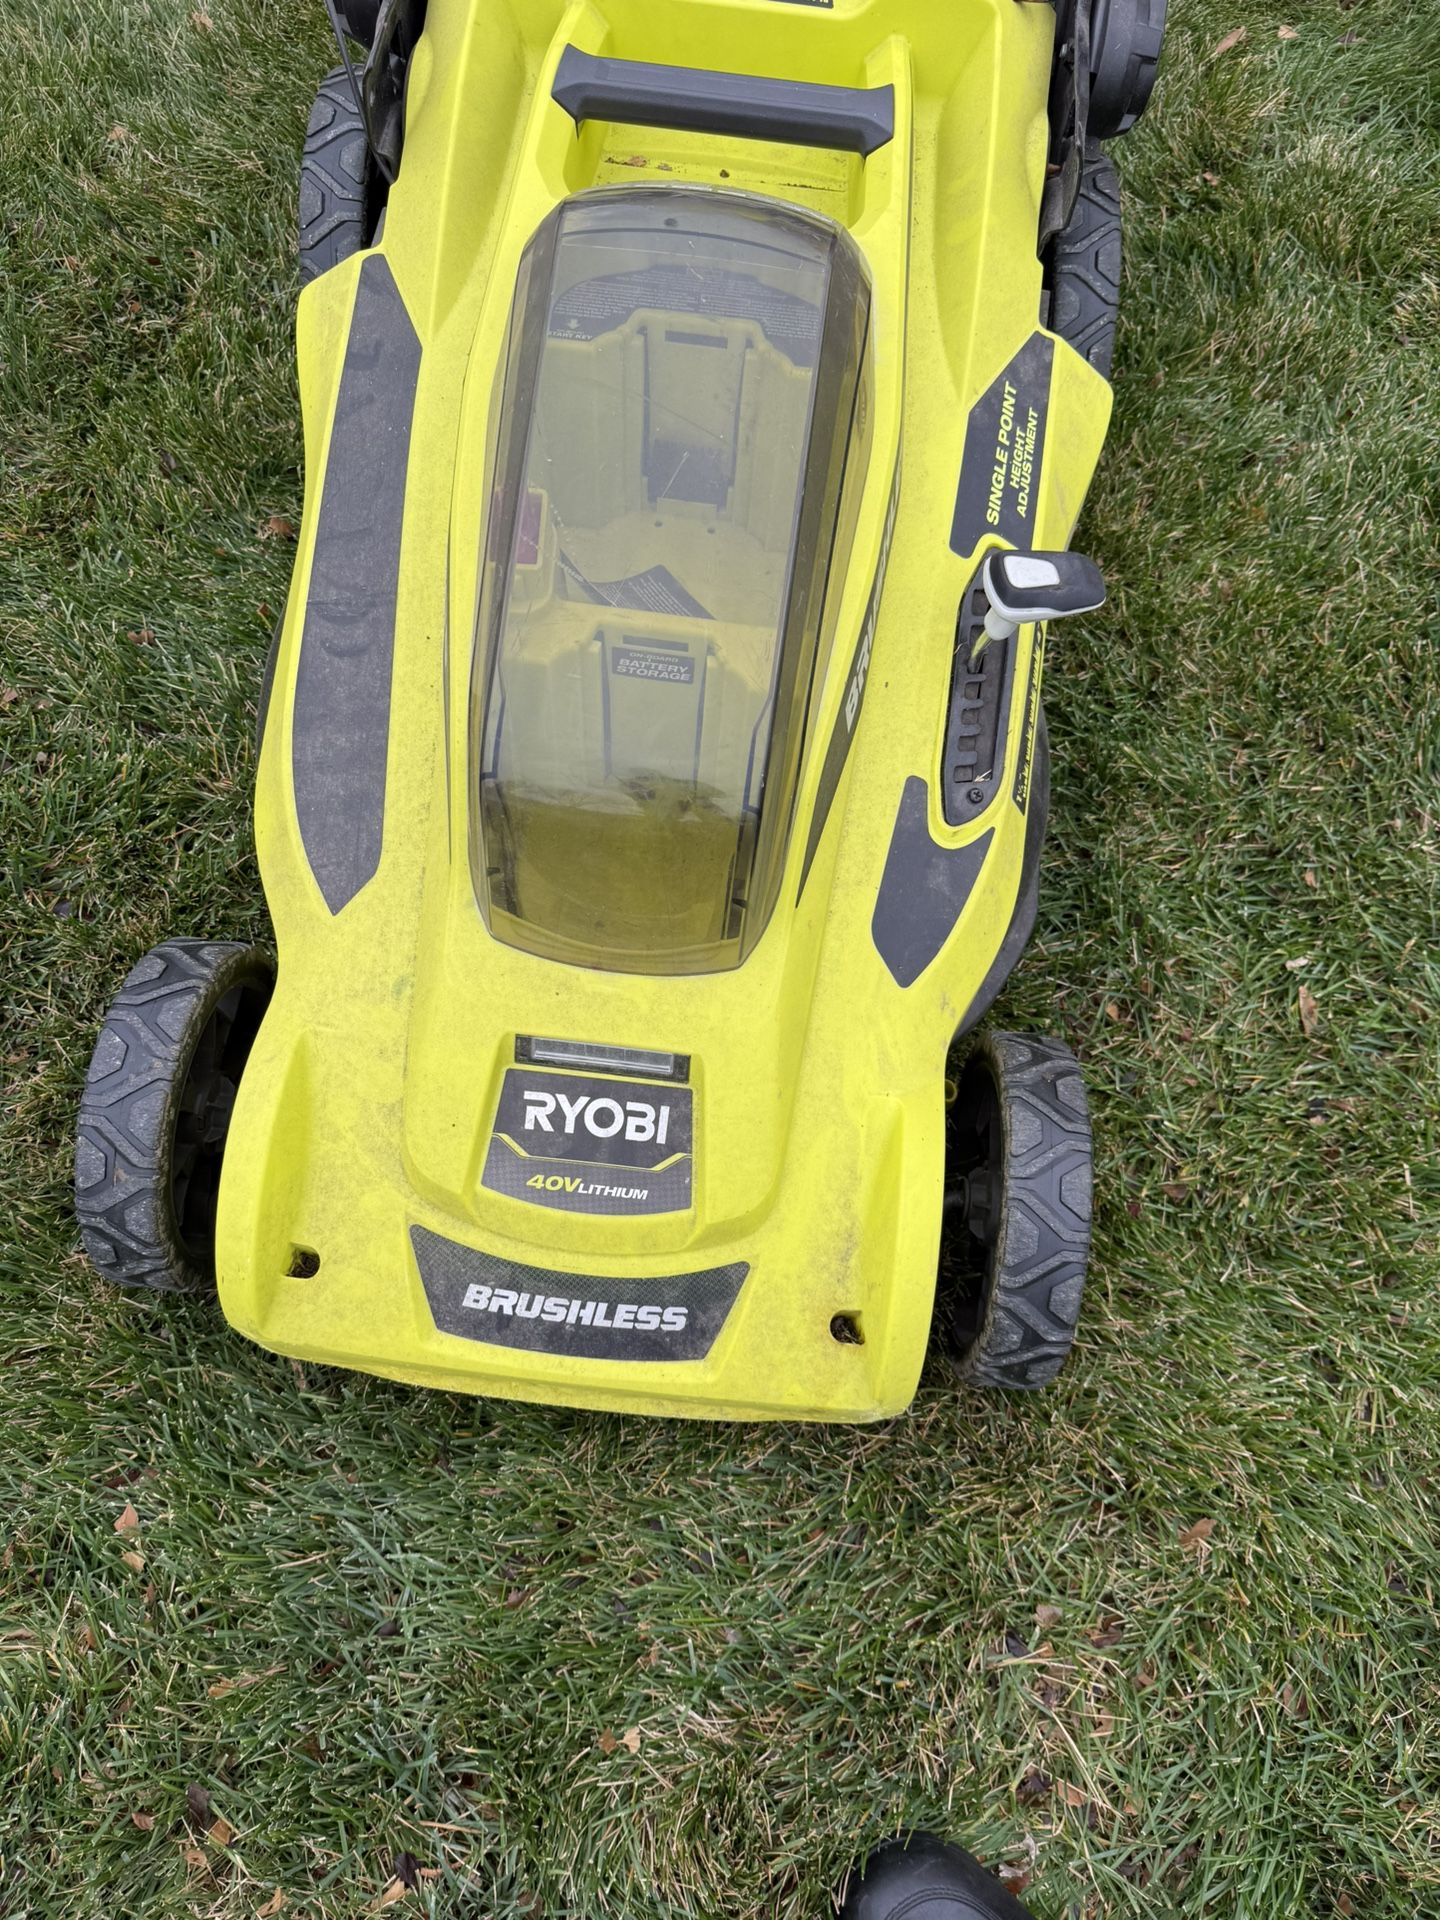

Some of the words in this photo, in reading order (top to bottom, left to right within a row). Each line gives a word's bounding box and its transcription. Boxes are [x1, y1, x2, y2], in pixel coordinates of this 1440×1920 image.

[986, 447, 1008, 526] SINGLE
[997, 381, 1017, 446] POINT
[1009, 427, 1026, 489] HEIGHT
[1016, 407, 1038, 519] ADJUSTMENT
[617, 665, 690, 681] STORAGE
[619, 658, 689, 673] BATTERY
[523, 1090, 670, 1144] RYOBI
[526, 1174, 582, 1193] 40V
[577, 1184, 648, 1200] LITHIUM
[462, 1283, 689, 1332] BRUSHLESS
